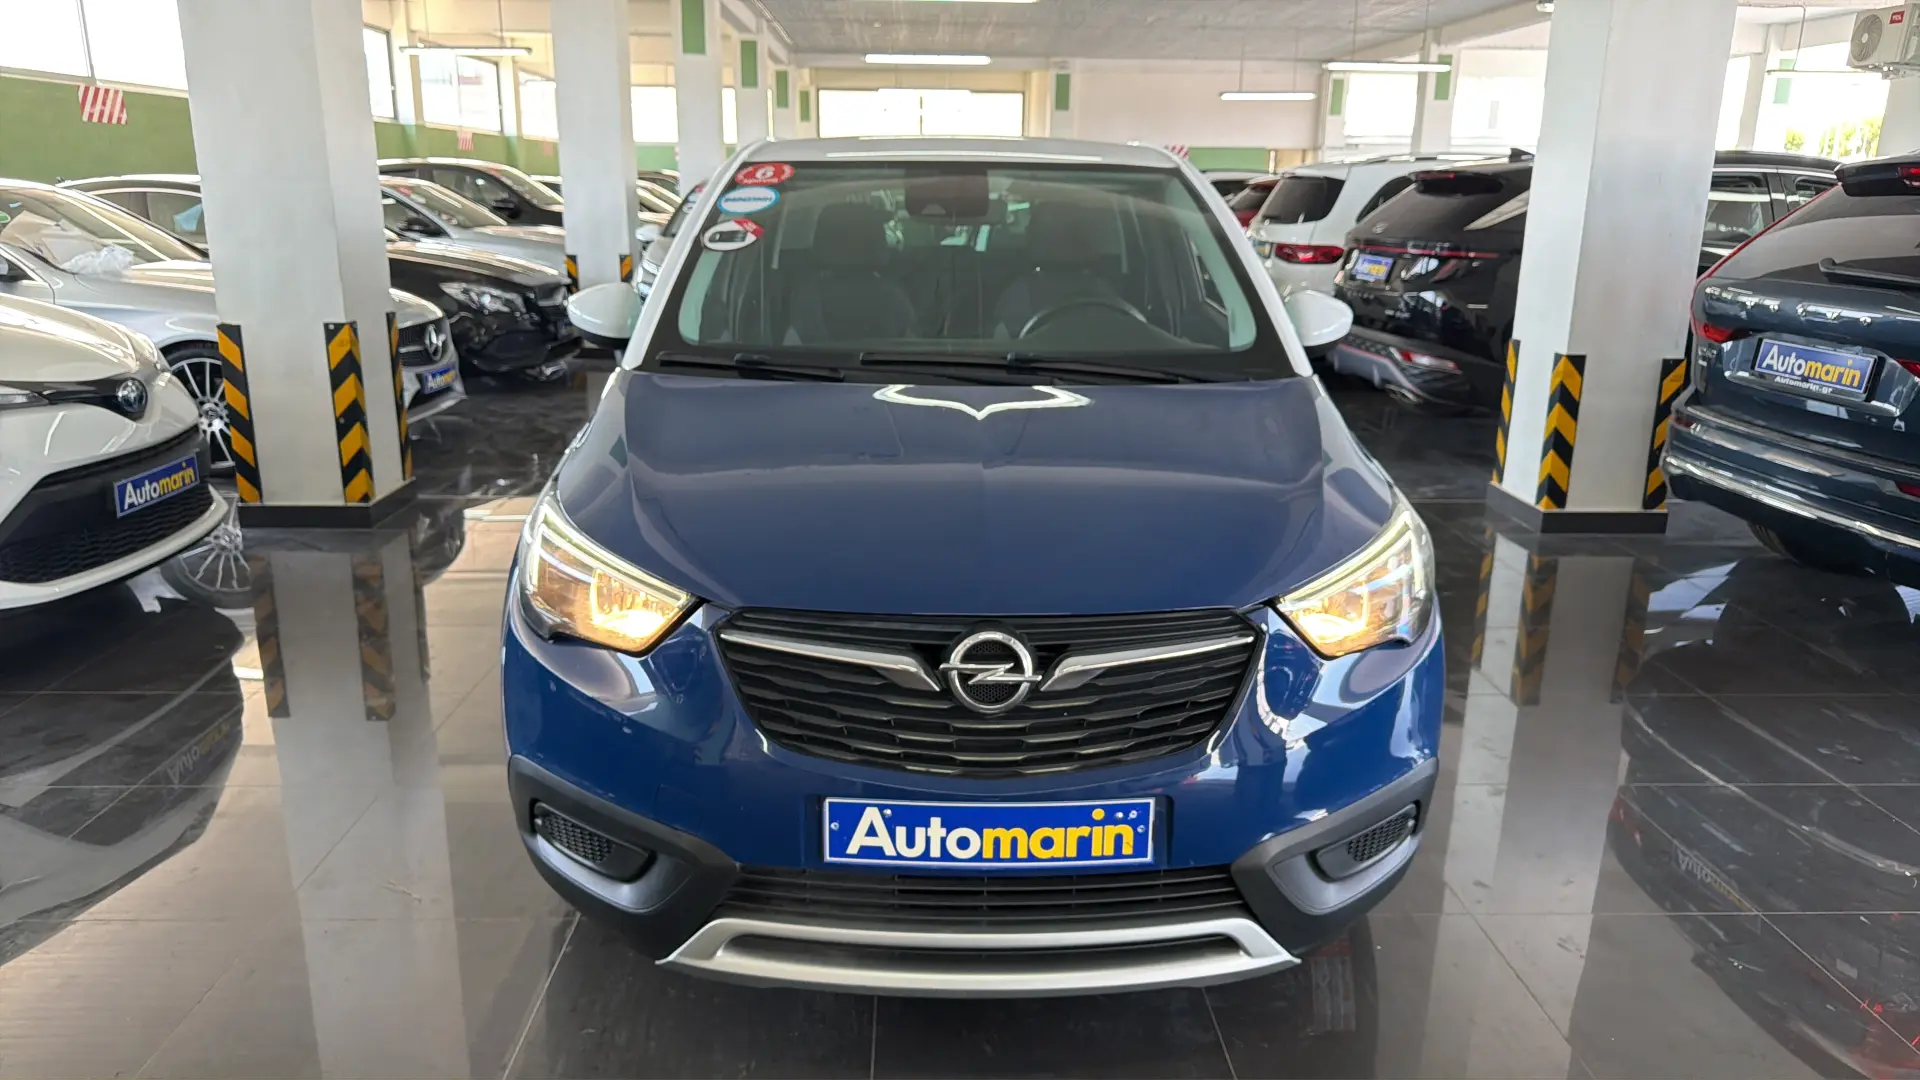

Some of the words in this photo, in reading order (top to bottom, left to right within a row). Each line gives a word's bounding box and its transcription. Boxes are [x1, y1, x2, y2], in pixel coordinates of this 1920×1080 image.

[1761, 344, 1861, 387] Automarin
[1774, 375, 1833, 394] Automarin.gr
[124, 461, 196, 510] Automarin
[845, 806, 1133, 859] Automarin
